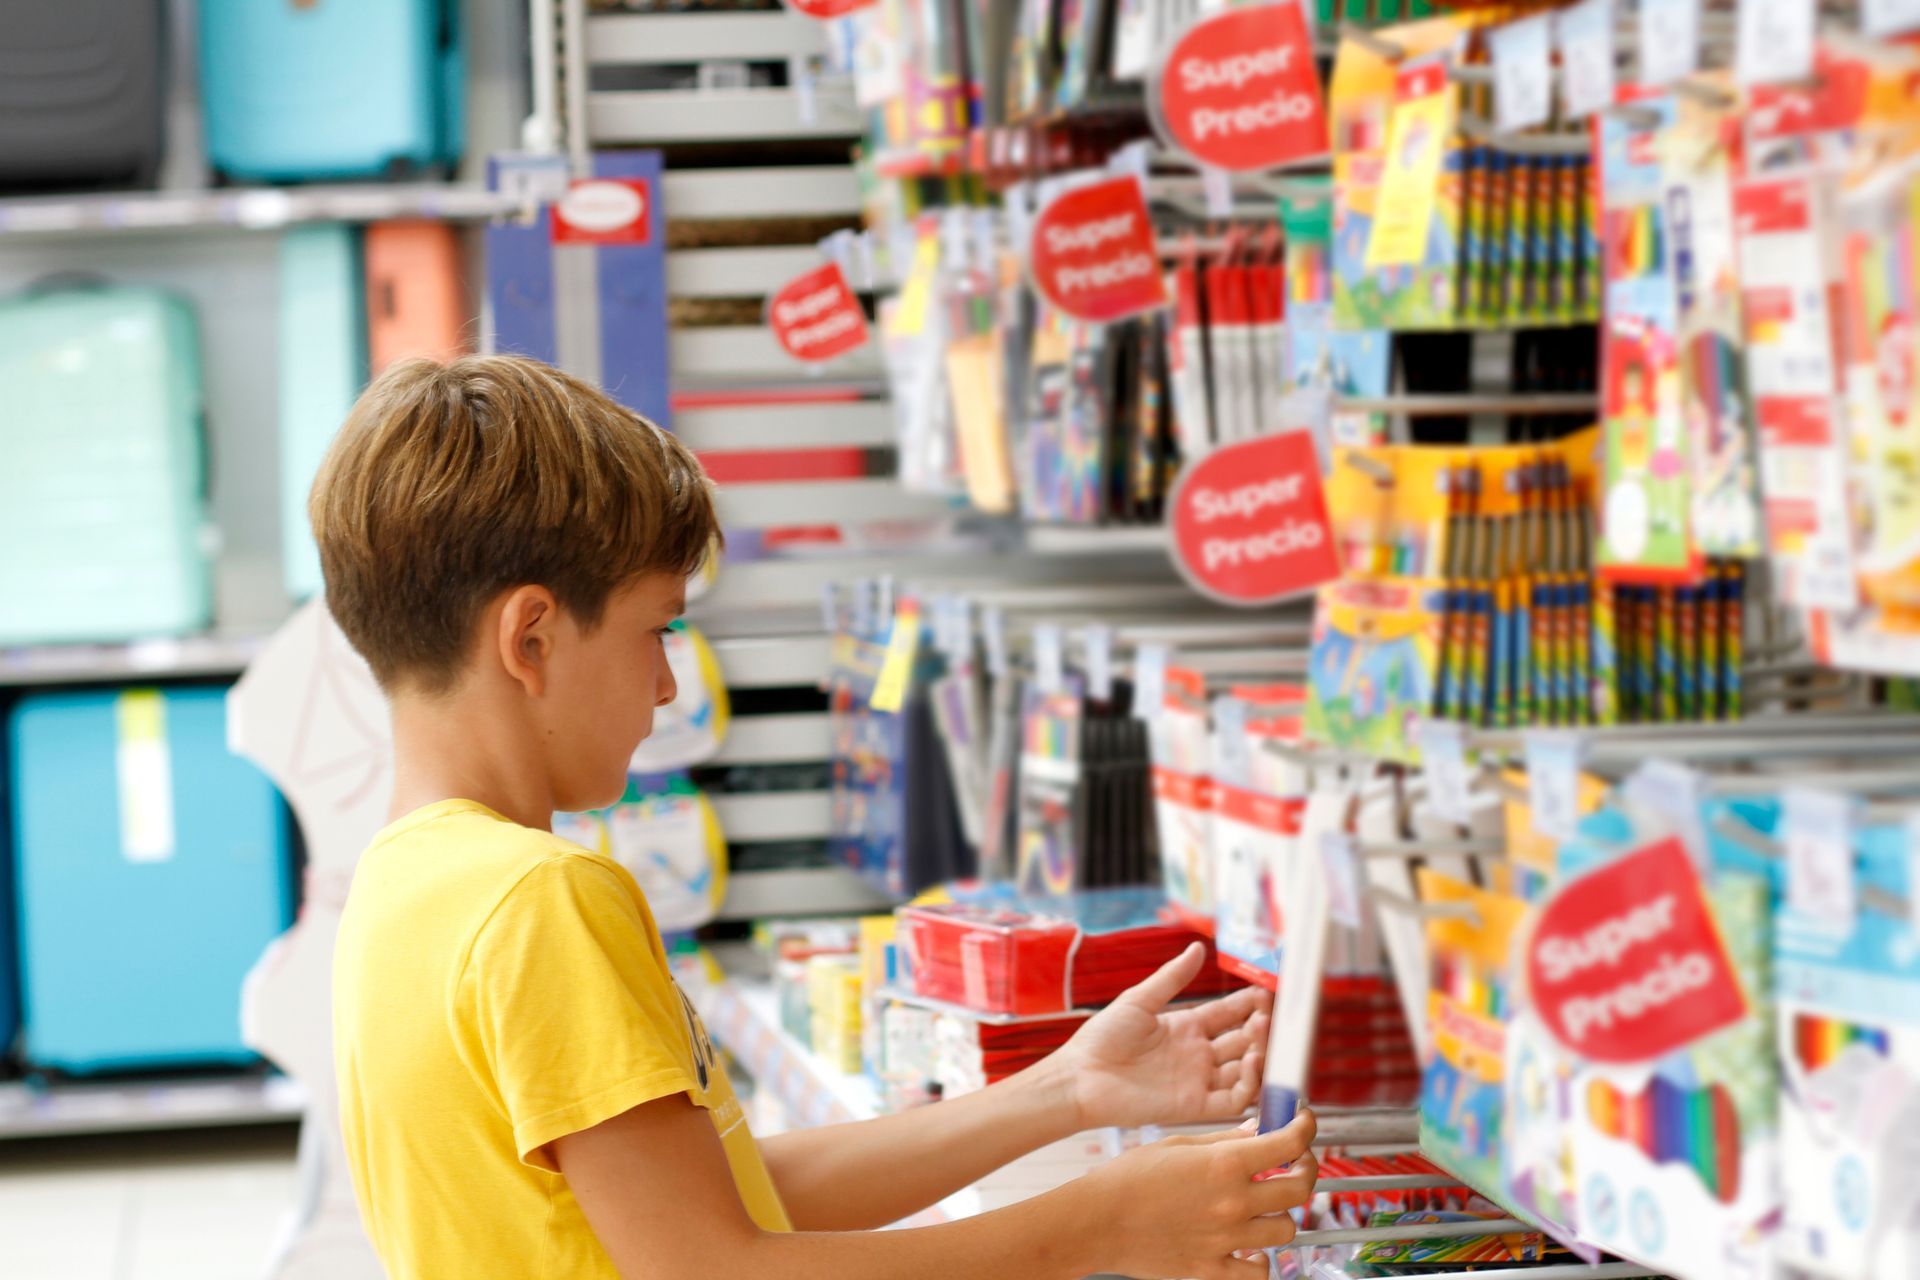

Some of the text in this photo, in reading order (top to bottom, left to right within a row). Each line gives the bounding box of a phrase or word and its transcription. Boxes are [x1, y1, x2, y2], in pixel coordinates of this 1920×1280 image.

[1182, 46, 1293, 90] Super
[1191, 90, 1313, 140] Precio
[1045, 212, 1136, 254] Super
[1057, 251, 1152, 294] Precio
[775, 285, 841, 323] Super
[1193, 475, 1302, 522] Super
[1204, 517, 1322, 569] Precio
[1538, 895, 1674, 981] Super
[1562, 953, 1712, 1040] Precio
